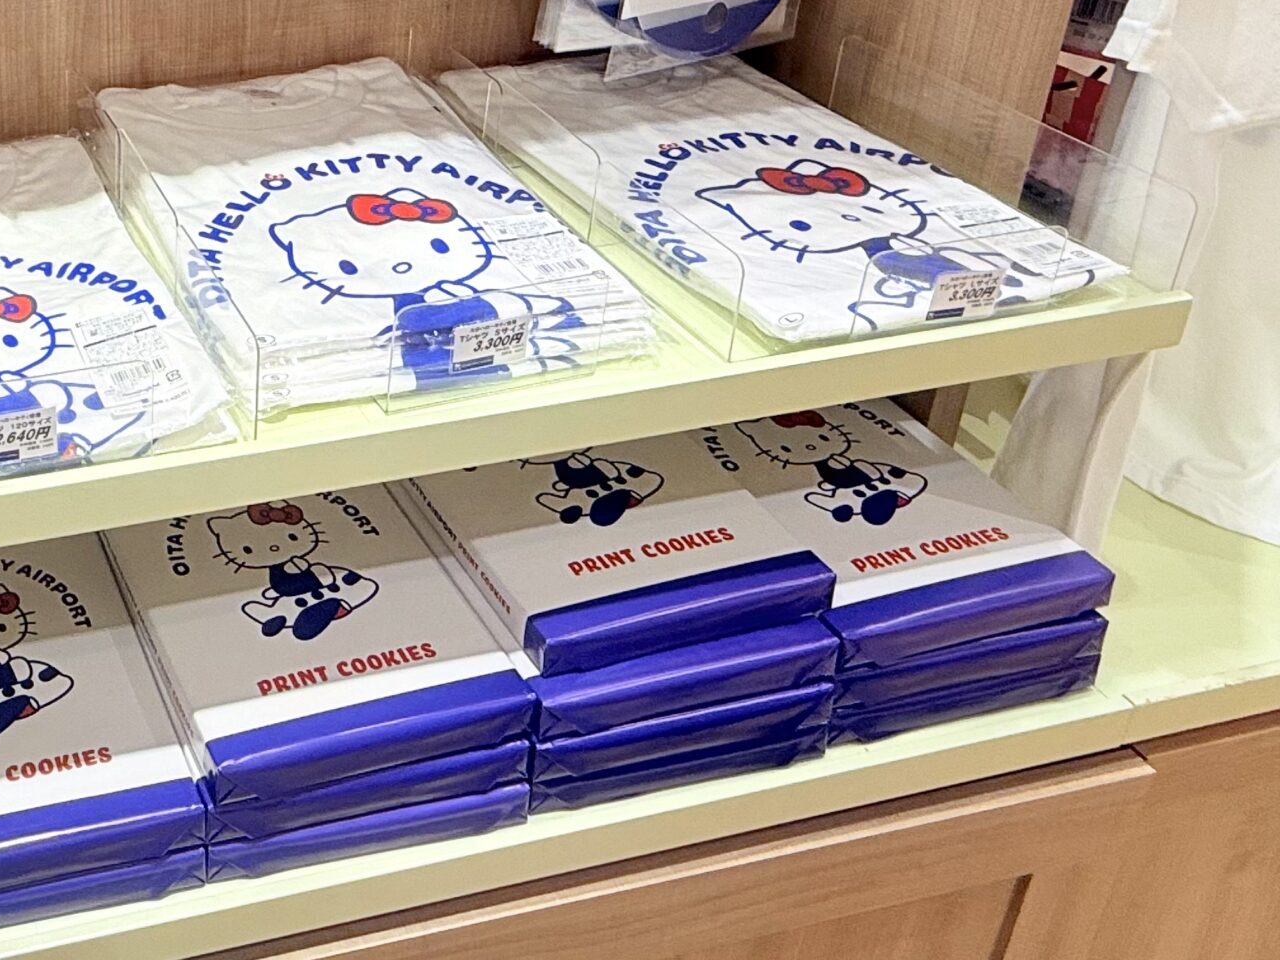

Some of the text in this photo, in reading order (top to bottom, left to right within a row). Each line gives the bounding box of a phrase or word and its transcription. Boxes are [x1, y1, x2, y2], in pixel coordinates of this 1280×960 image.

[628, 131, 799, 266] OITA HELLO KITTY
[188, 152, 423, 309] OITA HELLO KITTY
[473, 332, 524, 352] 3,300円
[11, 417, 53, 429] 120サイズ
[704, 434, 740, 473] OITA
[167, 533, 191, 576] OITA
[567, 527, 735, 577] PRINT COOKIES
[850, 526, 1010, 573] PRINT COOKIES
[14, 564, 91, 630] AIRPORT
[256, 642, 438, 697] PRINT COOKIES
[5, 746, 113, 782] COOKIES
